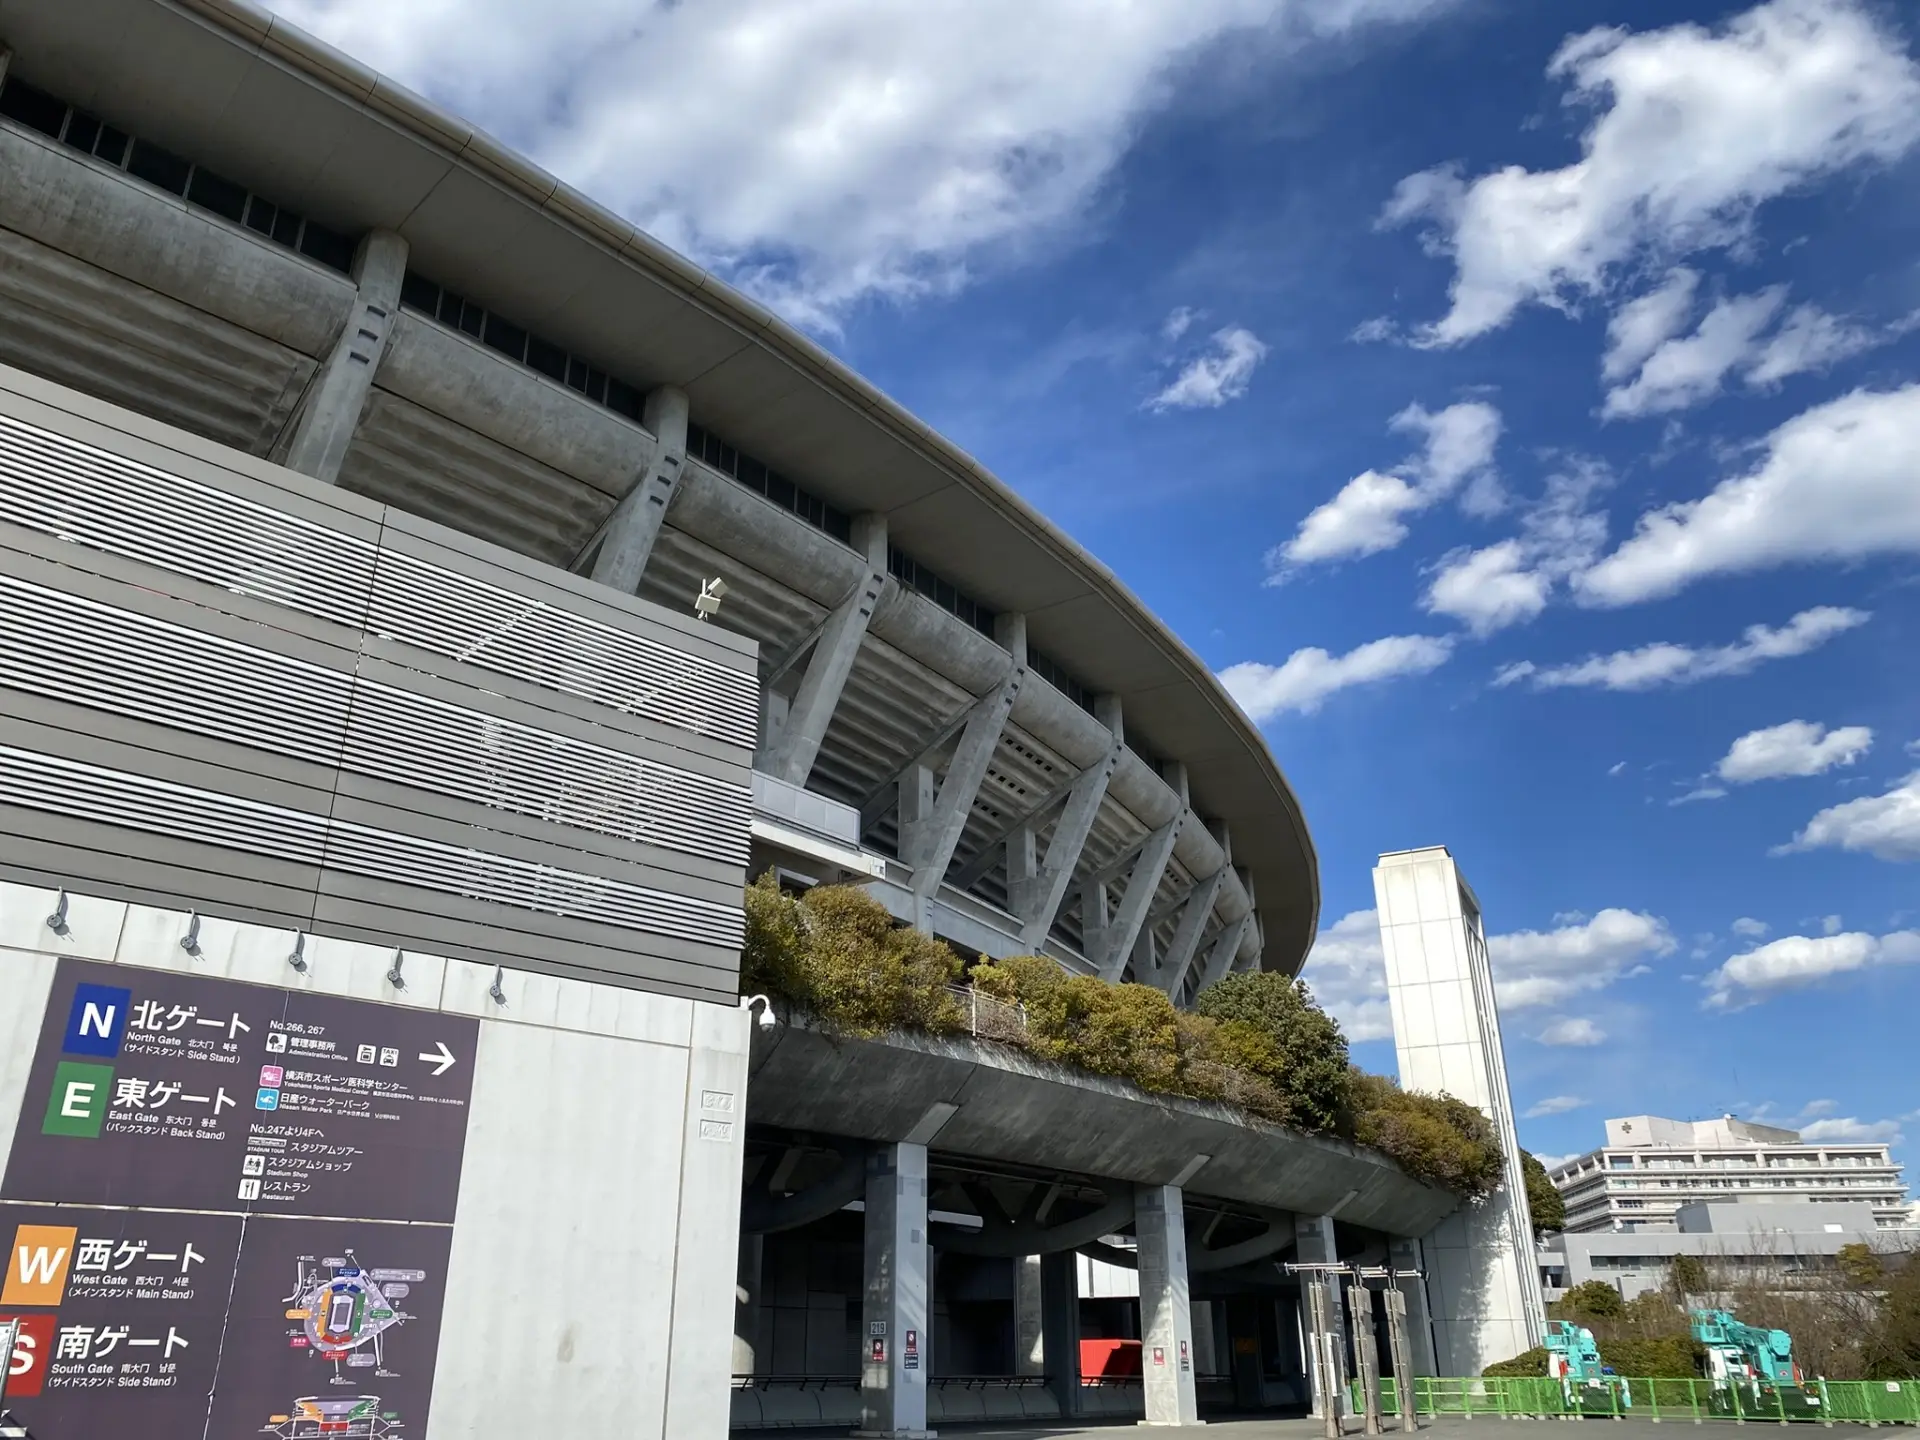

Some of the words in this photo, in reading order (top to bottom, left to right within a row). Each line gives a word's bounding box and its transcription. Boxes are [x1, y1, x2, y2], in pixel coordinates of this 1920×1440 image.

[79, 1002, 116, 1039] N
[130, 1000, 251, 1039] 北ゲート
[307, 1025, 325, 1035] 267
[127, 1031, 155, 1043] North
[157, 1035, 181, 1046] Gate
[290, 1037, 336, 1052] 管理事務所
[187, 1050, 208, 1060] Side
[288, 1049, 330, 1059] Administration
[331, 1053, 349, 1061] Office
[284, 1081, 312, 1089] Yokohama
[285, 1070, 408, 1091] 横浜市スポーツ医科学センター
[60, 1081, 96, 1118] E
[113, 1077, 236, 1115] 東ゲート
[108, 1110, 132, 1121] East
[135, 1112, 159, 1123] Gate
[170, 1127, 193, 1138] Back
[290, 1142, 364, 1156] スタジアムツアー
[268, 1157, 352, 1172] スタジアムショップ
[266, 1169, 291, 1177] Stadium
[292, 1171, 309, 1179] Shop
[263, 1181, 311, 1193] レストラン
[262, 1193, 295, 1201] Restaurant
[75, 1238, 206, 1273] 西ゲート
[18, 1246, 67, 1284] W
[72, 1274, 100, 1285] West
[102, 1275, 128, 1286] Gate
[136, 1289, 160, 1299] Main
[871, 1322, 885, 1334] 219
[56, 1325, 189, 1359] 南ゲート
[8, 1334, 36, 1375] S
[51, 1363, 84, 1374] South
[87, 1363, 114, 1374] Gate
[118, 1377, 141, 1387] Side
